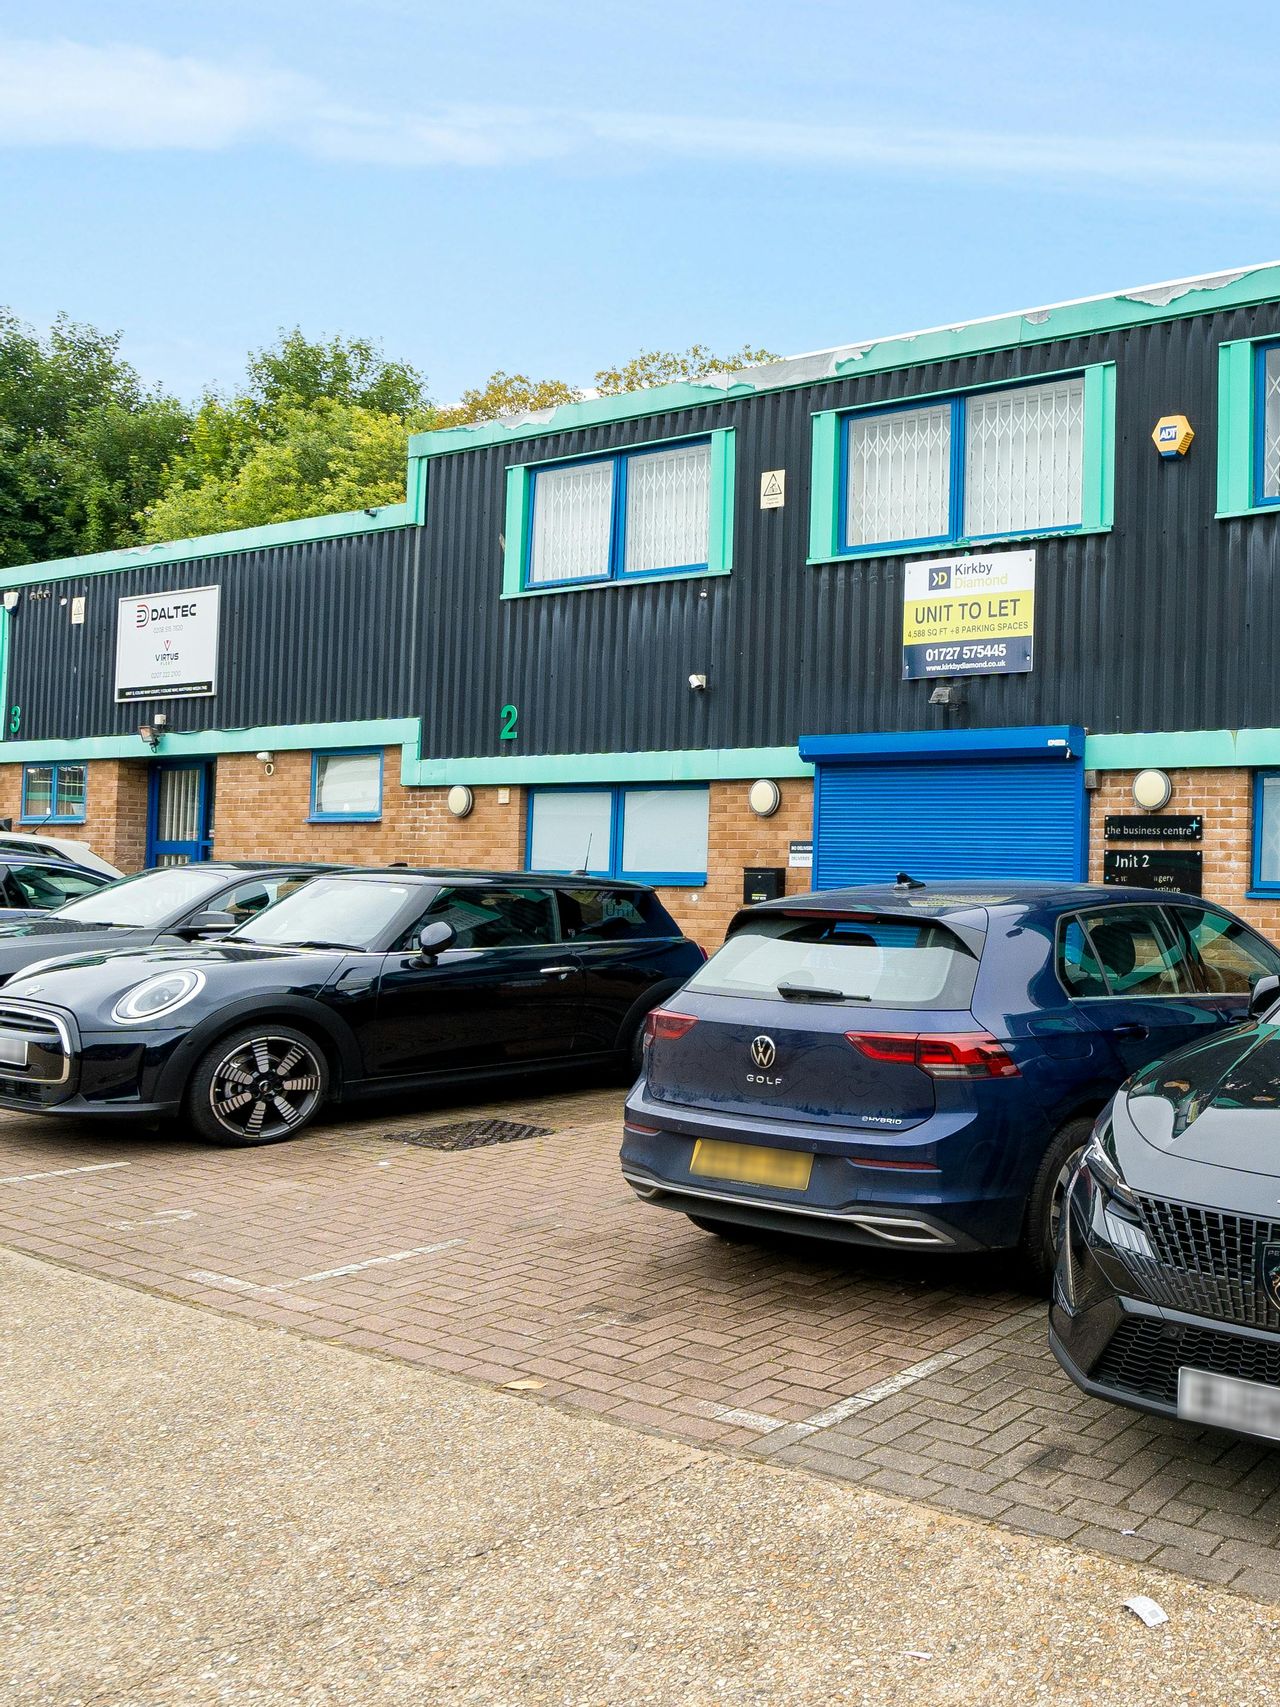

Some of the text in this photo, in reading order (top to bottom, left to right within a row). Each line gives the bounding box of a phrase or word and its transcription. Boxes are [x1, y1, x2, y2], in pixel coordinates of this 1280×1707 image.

[1160, 428, 1178, 440] ADT
[955, 562, 992, 575] Kirkby
[955, 573, 1008, 589] Diamond
[151, 604, 197, 621] DALTEC
[915, 599, 1020, 624] UNIT TO LET
[927, 628, 937, 636] SQ
[939, 627, 947, 635] FT
[961, 623, 995, 634] PARKING
[997, 621, 1028, 631] SPACES
[155, 652, 180, 661] VIRTUS
[925, 643, 1007, 662] 01727 575445
[926, 660, 1006, 672] www.kirkbydiamond.co.uk
[10, 705, 21, 733] 3
[501, 704, 518, 739] 2
[1106, 825, 1192, 835] the business centre
[1141, 854, 1150, 868] 2
[746, 1074, 783, 1086] GOLF
